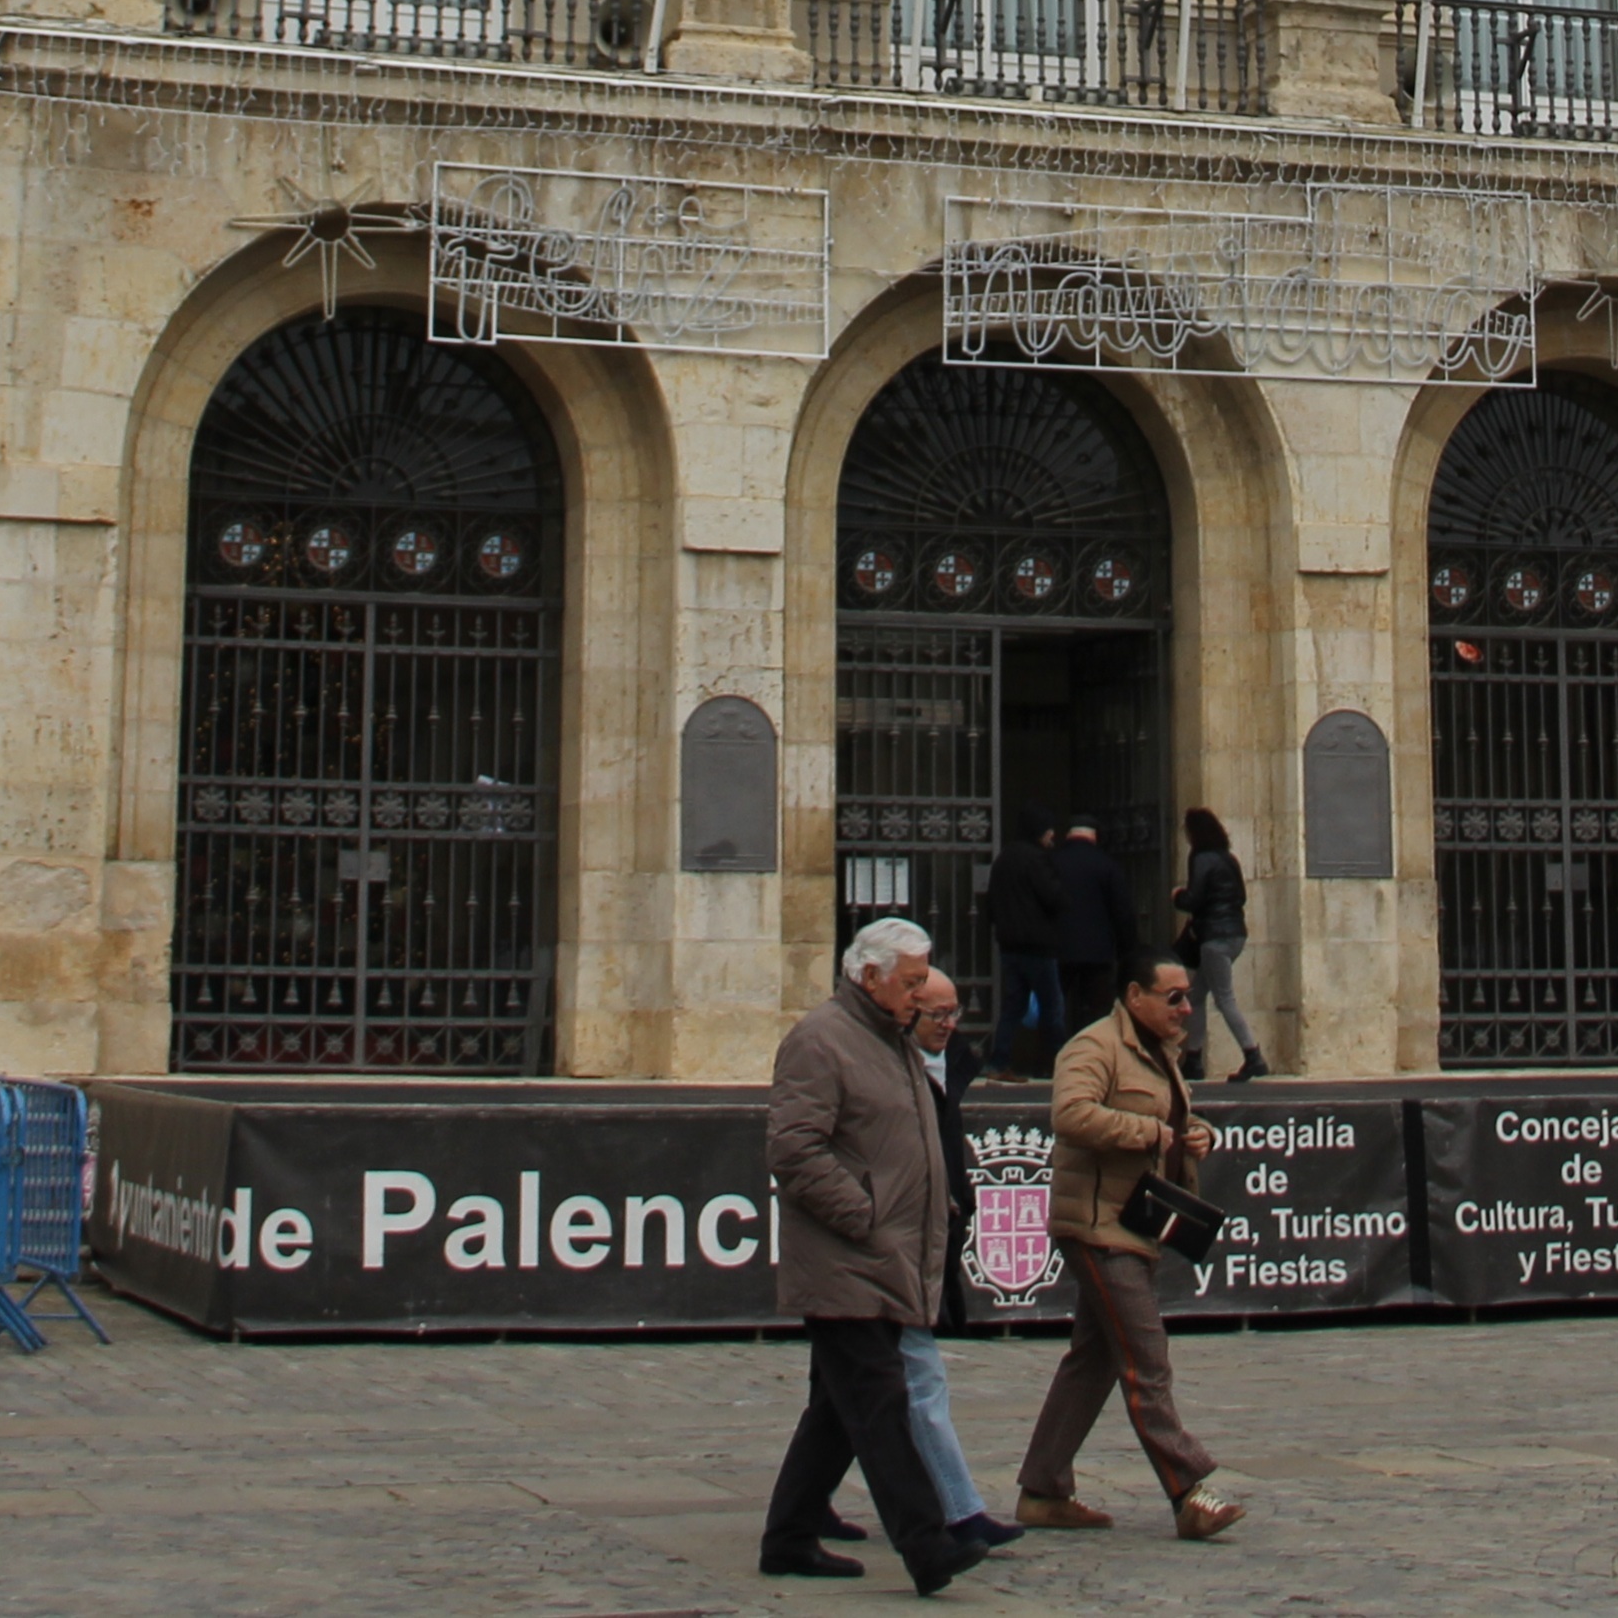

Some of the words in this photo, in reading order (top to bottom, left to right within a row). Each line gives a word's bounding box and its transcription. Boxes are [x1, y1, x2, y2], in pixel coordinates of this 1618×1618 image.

[1212, 1116, 1355, 1157] ncejalía
[1245, 1163, 1288, 1195] de
[1561, 1153, 1602, 1184] de
[217, 1187, 313, 1270] de
[362, 1170, 780, 1270] Palenc
[1270, 1206, 1406, 1239] Turismo
[1455, 1200, 1574, 1233] Cultura,
[1193, 1262, 1214, 1296] y
[1226, 1254, 1348, 1287] Fiestas
[1518, 1251, 1536, 1283] y
